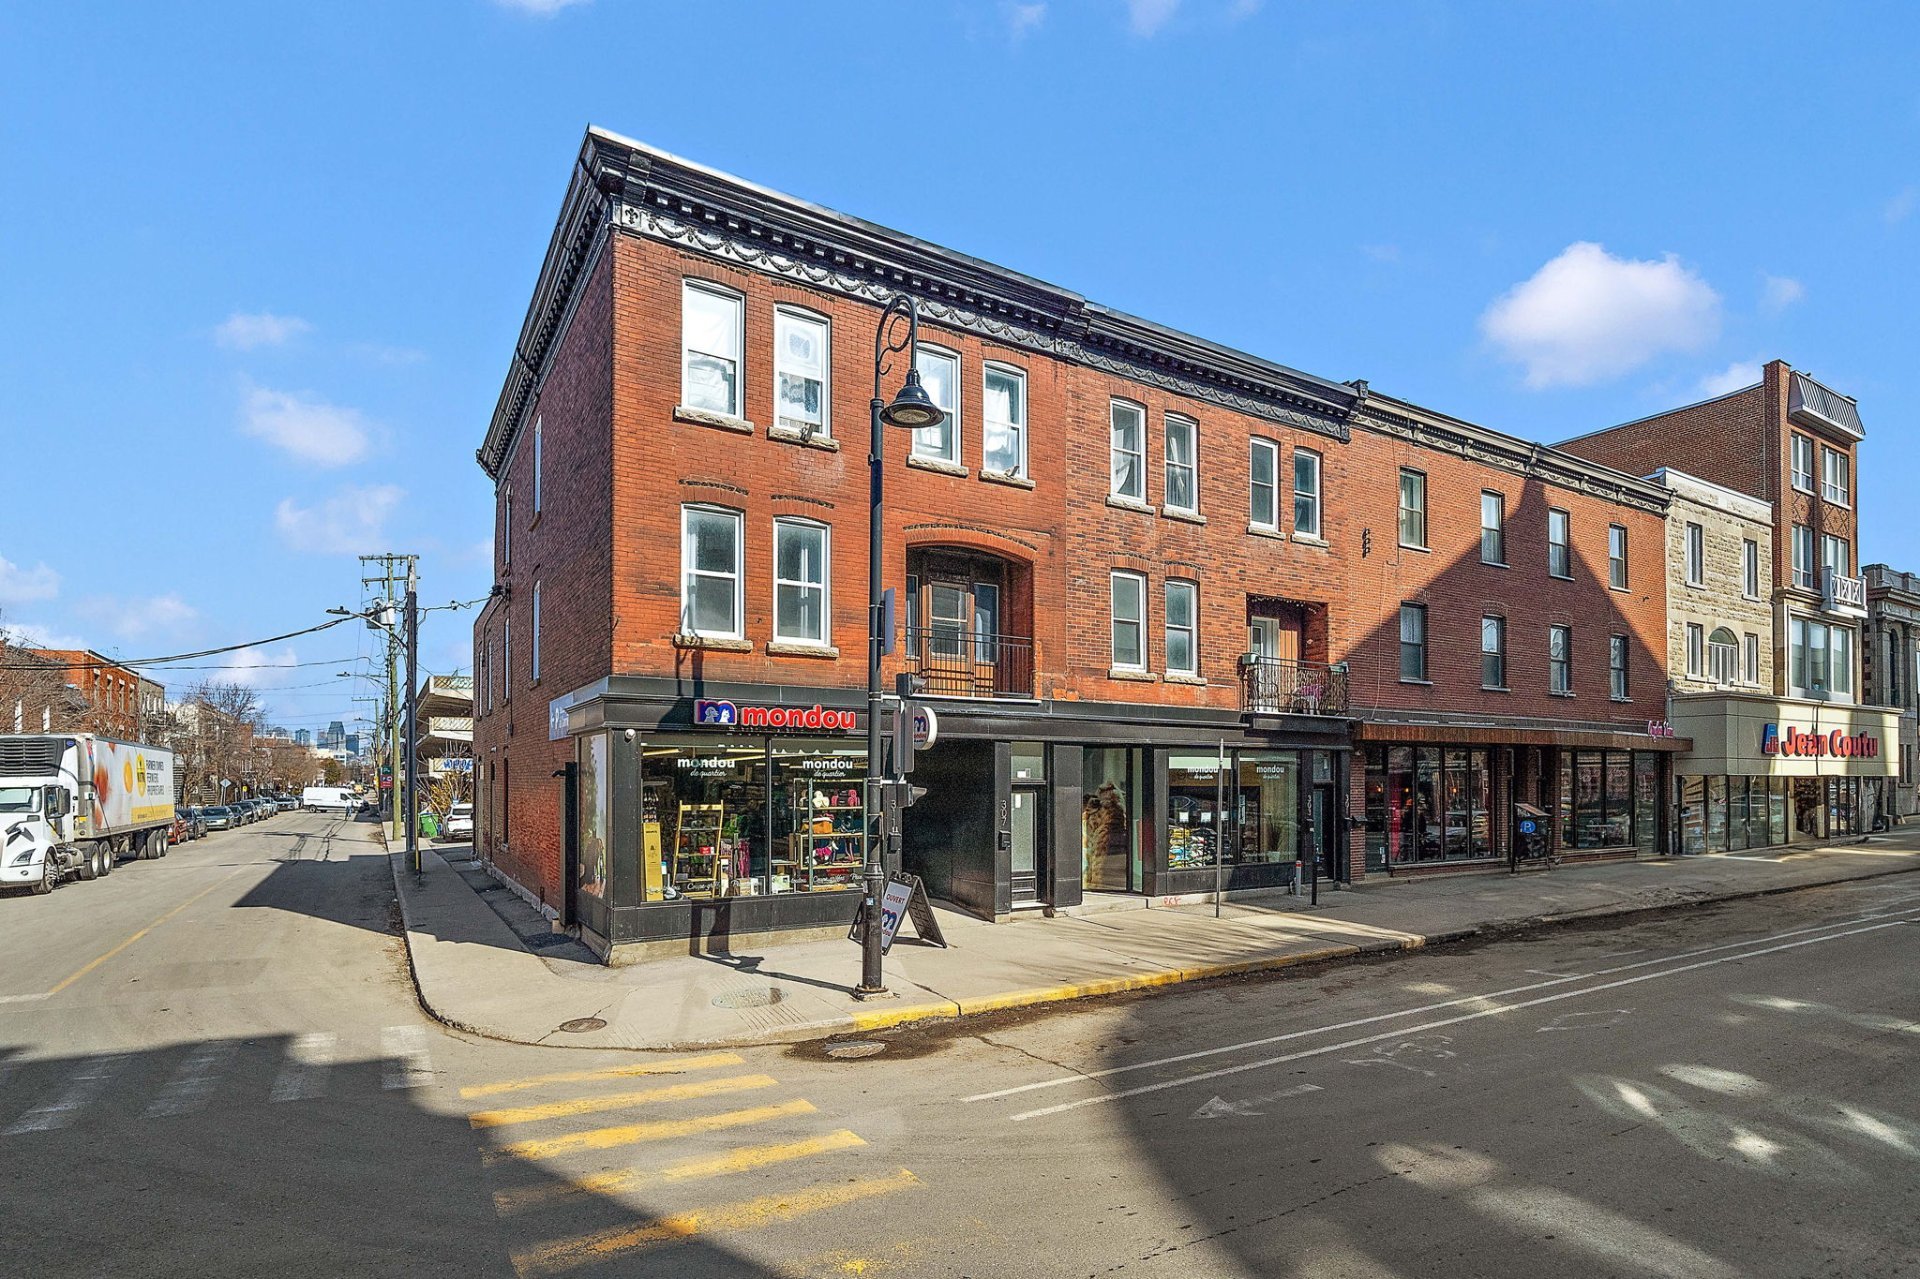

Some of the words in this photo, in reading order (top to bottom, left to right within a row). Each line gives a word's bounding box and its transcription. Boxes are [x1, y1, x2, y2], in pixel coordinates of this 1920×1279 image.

[741, 704, 856, 730] mondou
[1782, 726, 1828, 757] Jean
[1829, 729, 1878, 758] Coutu
[677, 756, 735, 768] mondou
[802, 758, 854, 769] mondou
[1257, 765, 1285, 773] mondou
[886, 893, 906, 904] OUVERT
